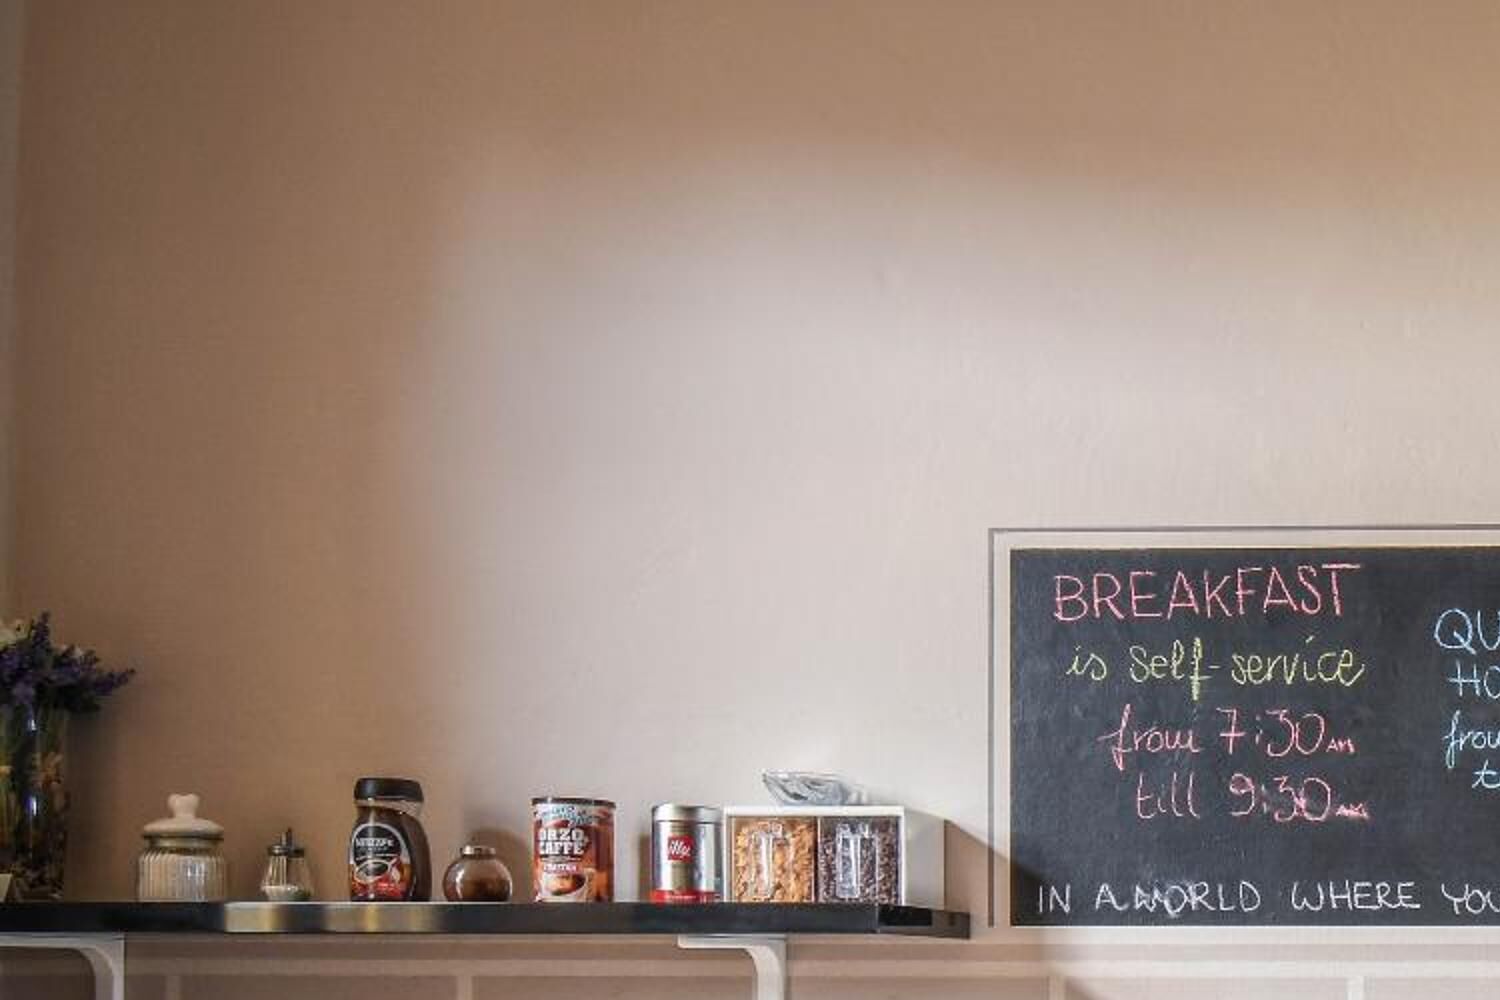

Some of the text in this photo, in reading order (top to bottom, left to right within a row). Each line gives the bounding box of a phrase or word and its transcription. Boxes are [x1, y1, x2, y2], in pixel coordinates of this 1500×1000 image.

[1054, 562, 1361, 623] BREAKFAST
[1064, 645, 1108, 681] is
[1097, 703, 1201, 771] from
[1136, 772, 1200, 819] till
[1037, 883, 1071, 914] IN
[1291, 881, 1420, 914] WHERE
